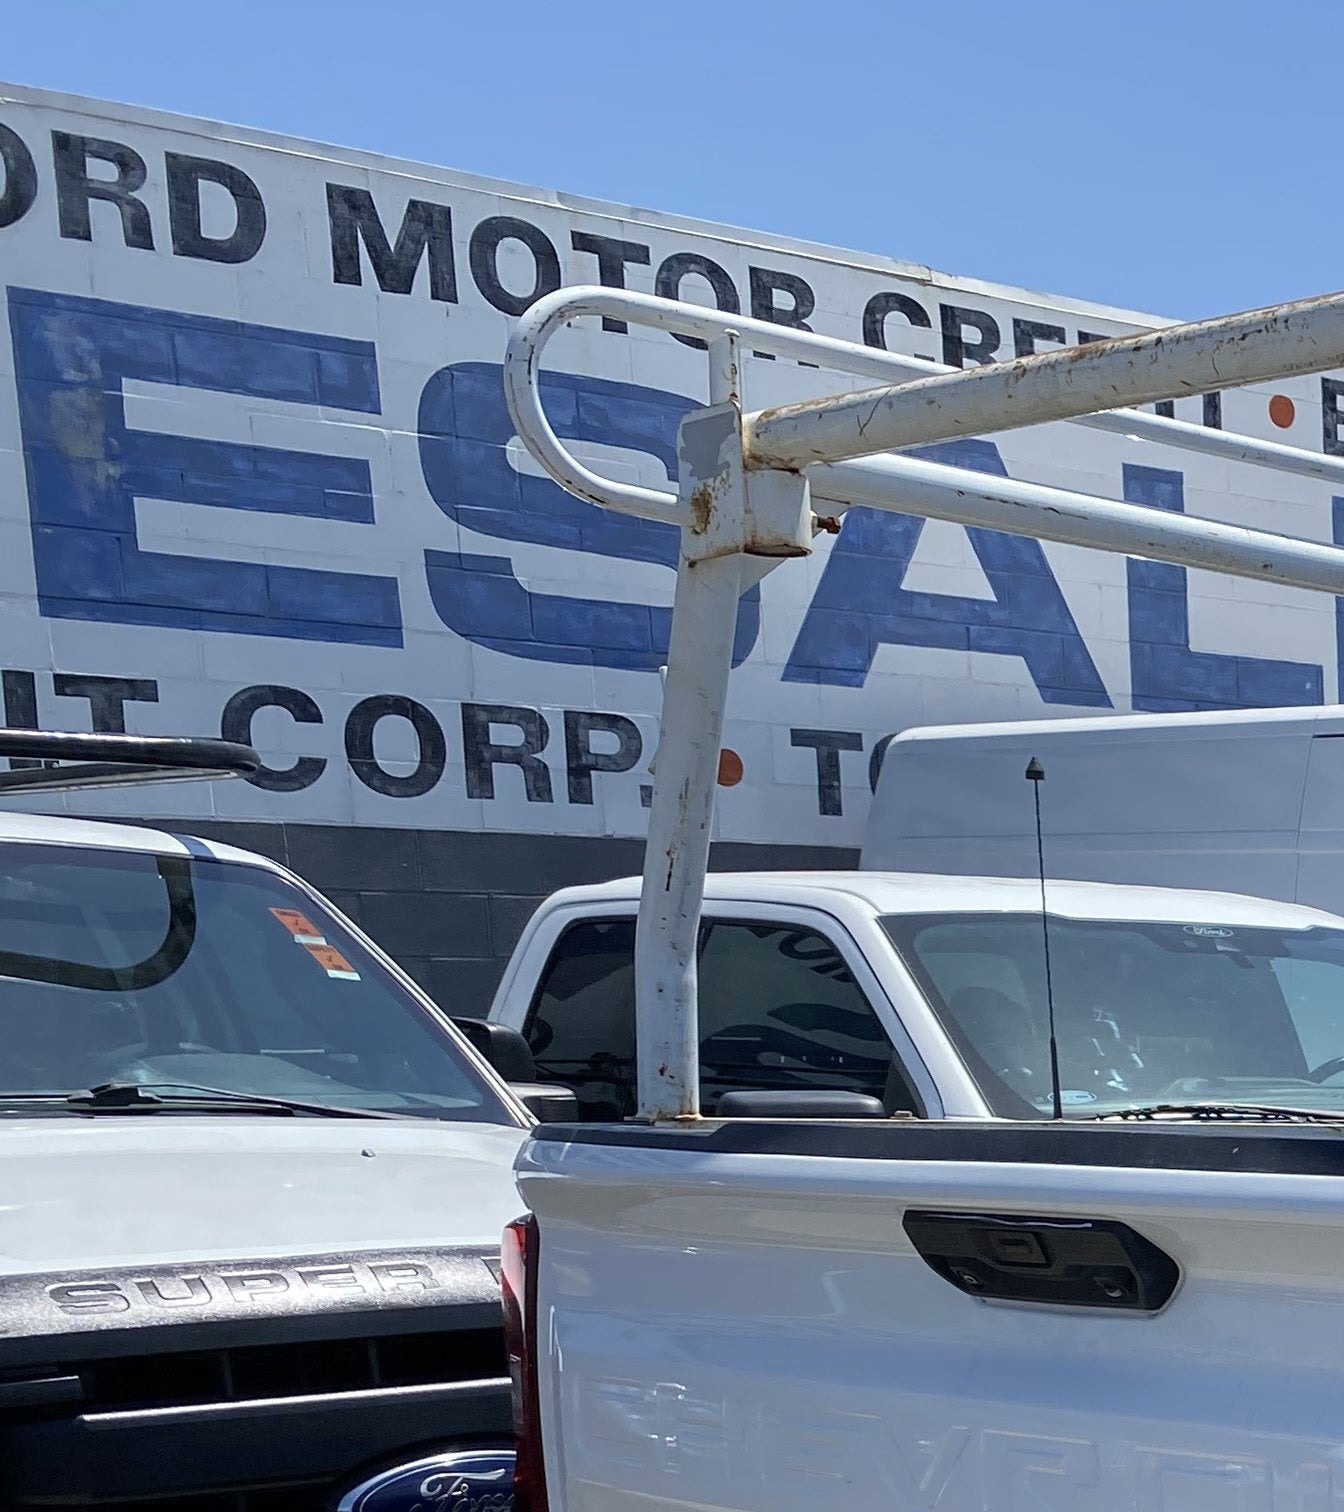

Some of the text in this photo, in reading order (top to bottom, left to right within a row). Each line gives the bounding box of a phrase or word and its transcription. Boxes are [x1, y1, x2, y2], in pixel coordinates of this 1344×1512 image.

[325, 182, 820, 369] MOTOR
[789, 728, 896, 818] T
[46, 1259, 441, 1317] SUPER
